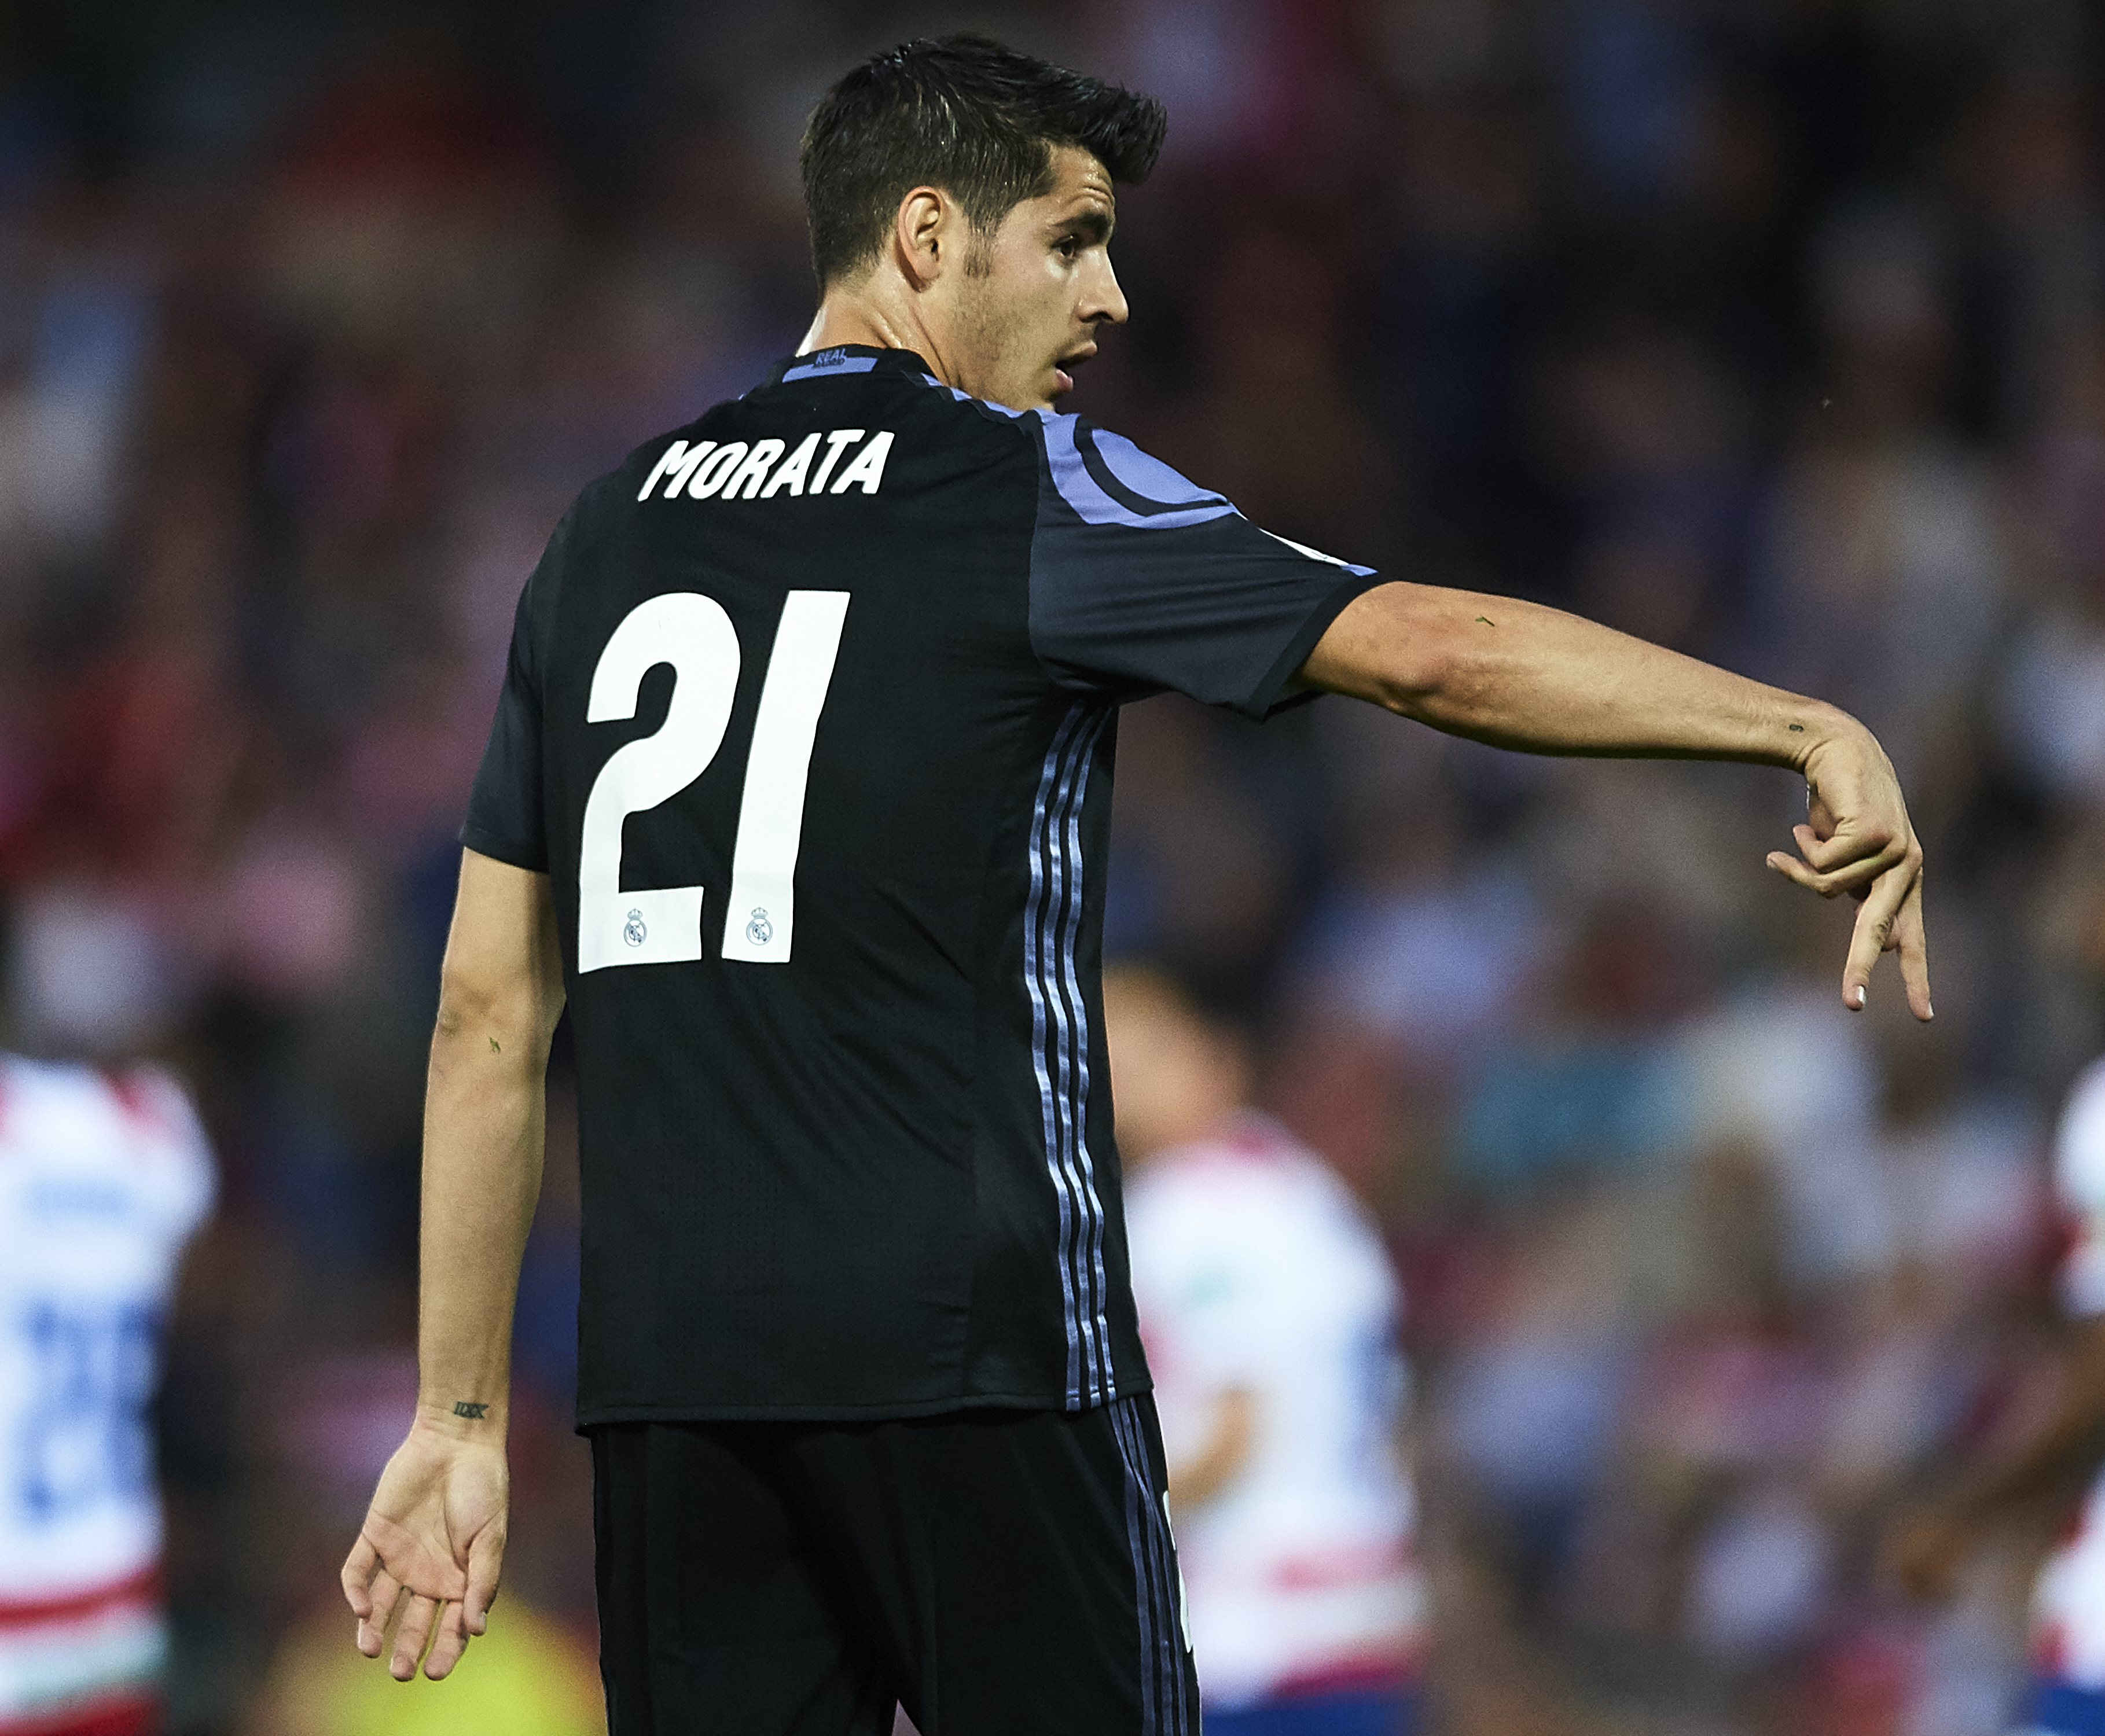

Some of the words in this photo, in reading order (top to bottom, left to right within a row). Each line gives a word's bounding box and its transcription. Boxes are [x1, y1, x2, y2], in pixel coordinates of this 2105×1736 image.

[815, 348, 847, 365] REAL
[637, 429, 895, 502] MORATA
[578, 590, 851, 974] 21
